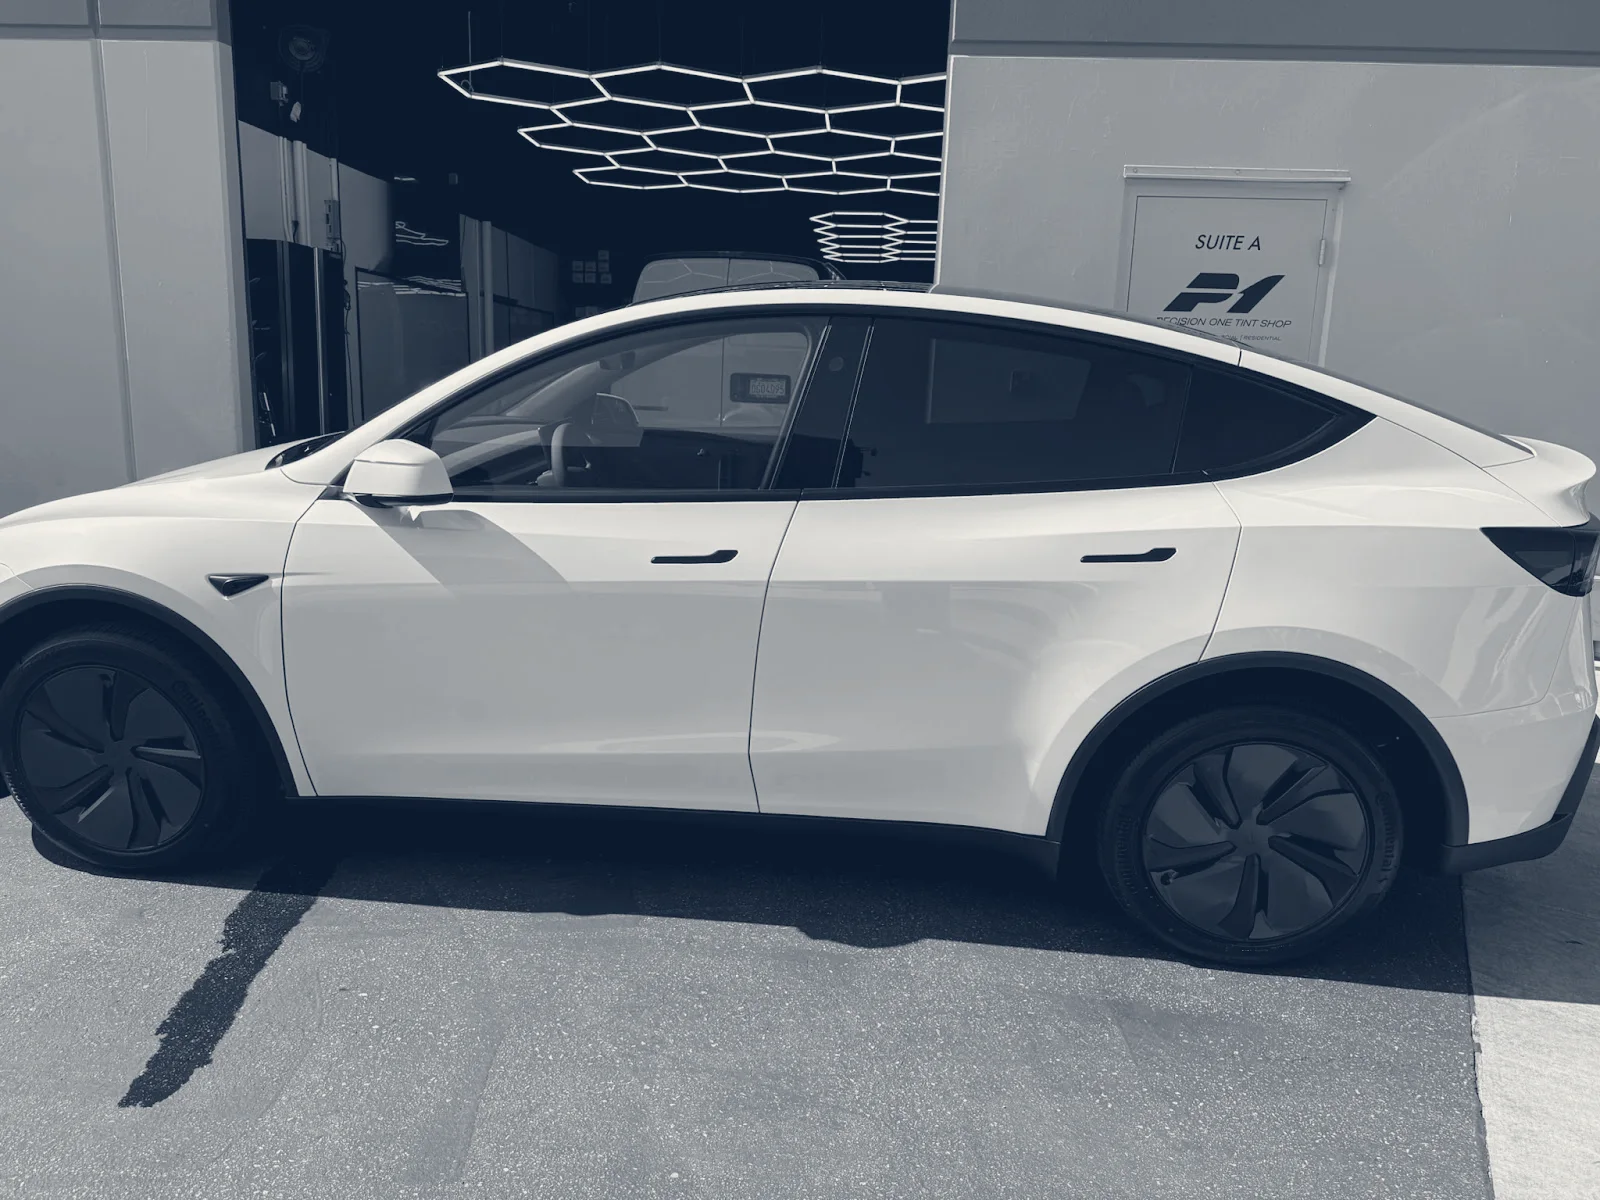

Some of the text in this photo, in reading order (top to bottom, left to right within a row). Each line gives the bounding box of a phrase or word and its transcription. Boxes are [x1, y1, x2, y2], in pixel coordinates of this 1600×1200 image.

[1195, 234, 1261, 251] SUITE A
[1163, 272, 1286, 314] P1
[1209, 318, 1233, 328] ONE
[1234, 318, 1260, 329] TINT
[1260, 319, 1292, 329] SHOP
